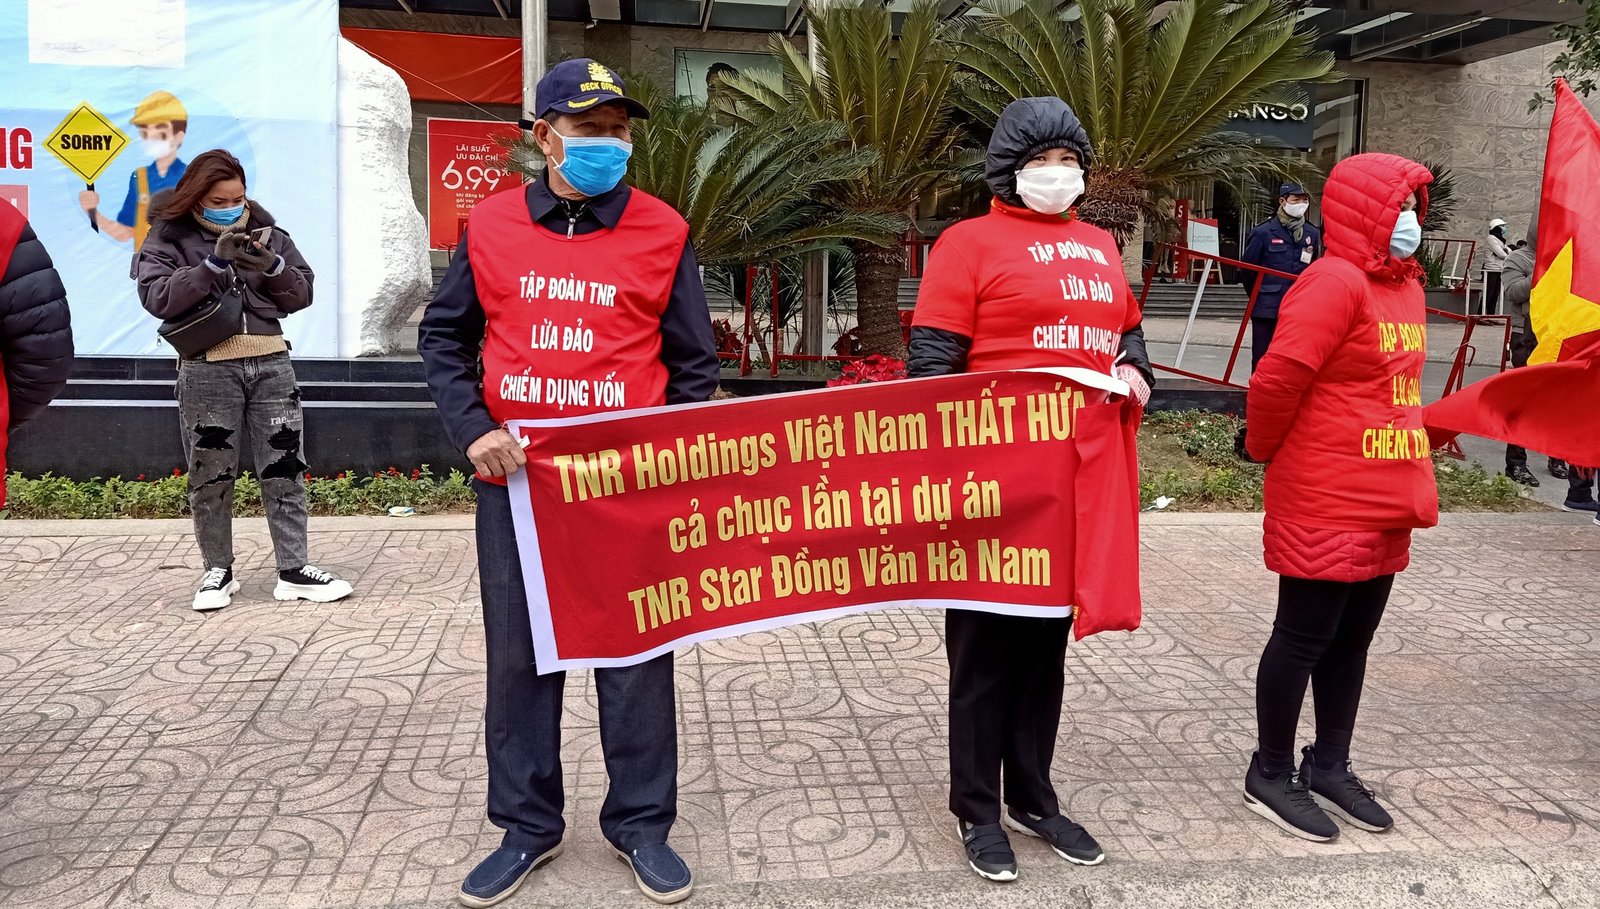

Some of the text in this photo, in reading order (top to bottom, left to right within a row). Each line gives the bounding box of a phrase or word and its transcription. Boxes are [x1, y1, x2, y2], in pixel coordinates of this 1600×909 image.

[580, 82, 600, 92] DECK
[1228, 103, 1309, 121] ANGO
[61, 134, 113, 151] SORRY
[470, 144, 491, 153] SUẤT
[1028, 241, 1055, 266] TẬP
[1056, 237, 1091, 261] ĐOÀN
[519, 270, 617, 308] TẬP ĐOÀN TNR
[1059, 272, 1114, 304] LỪA ĐẢO
[530, 318, 594, 353] LỪA ĐẢO
[1032, 315, 1080, 350] CHIẾM
[1083, 325, 1112, 357] DỤNG
[500, 366, 626, 411] CHIẾM DỤNG VỐN
[553, 448, 626, 504] TNR
[631, 432, 778, 491] Holdings
[784, 415, 846, 469] Việt
[854, 409, 929, 456] Nam
[936, 380, 1017, 449] THẤT
[1362, 419, 1411, 460] CHIẾM
[668, 471, 1002, 553] cả chục lần tại dự án
[627, 538, 1051, 634] TNR Star Đồng Văn Hà Nam
